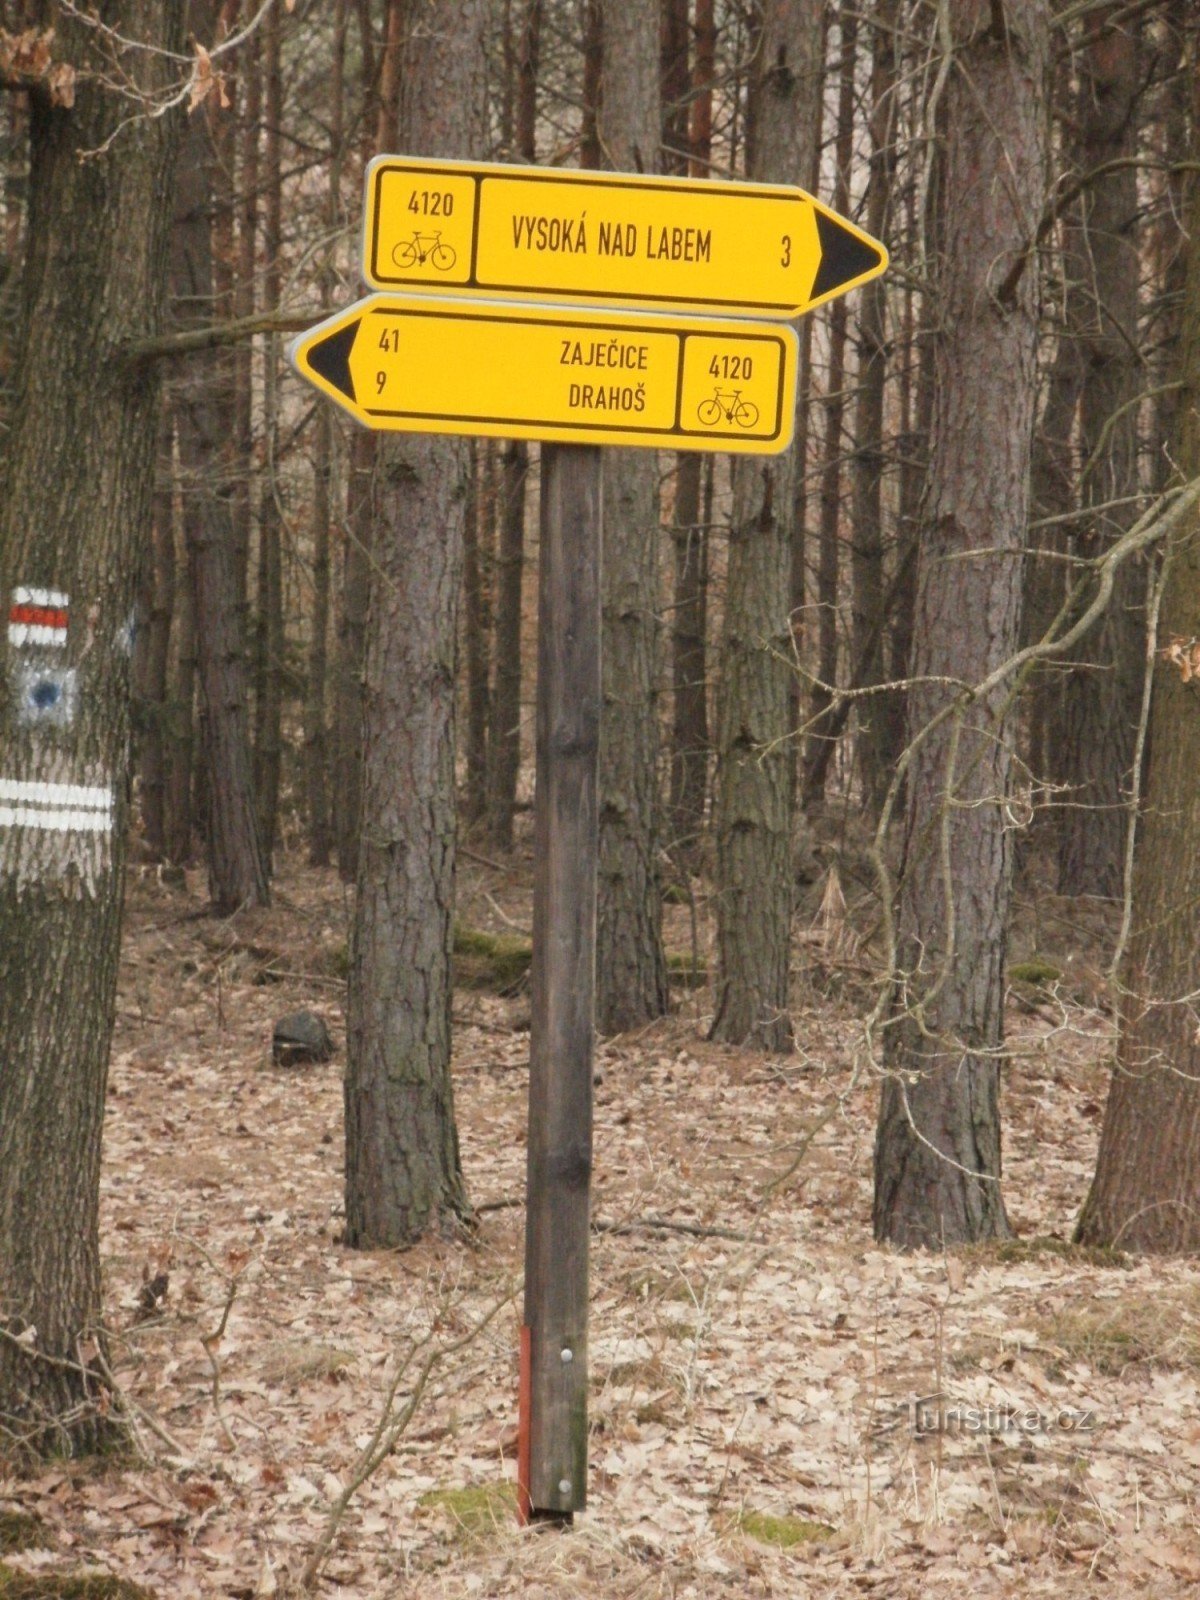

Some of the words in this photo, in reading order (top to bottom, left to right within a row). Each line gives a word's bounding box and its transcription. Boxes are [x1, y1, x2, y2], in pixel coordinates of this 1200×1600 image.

[407, 190, 454, 217] 4120
[512, 210, 587, 254] VYSOKÁ
[598, 221, 638, 258] NAD
[646, 225, 712, 263] LABEM
[780, 234, 792, 269] 3
[378, 328, 400, 353] 41
[559, 338, 649, 370] ZAJEČICE
[708, 354, 753, 381] 4120
[376, 370, 387, 395] 9
[568, 382, 646, 412] DRAHOŠ
